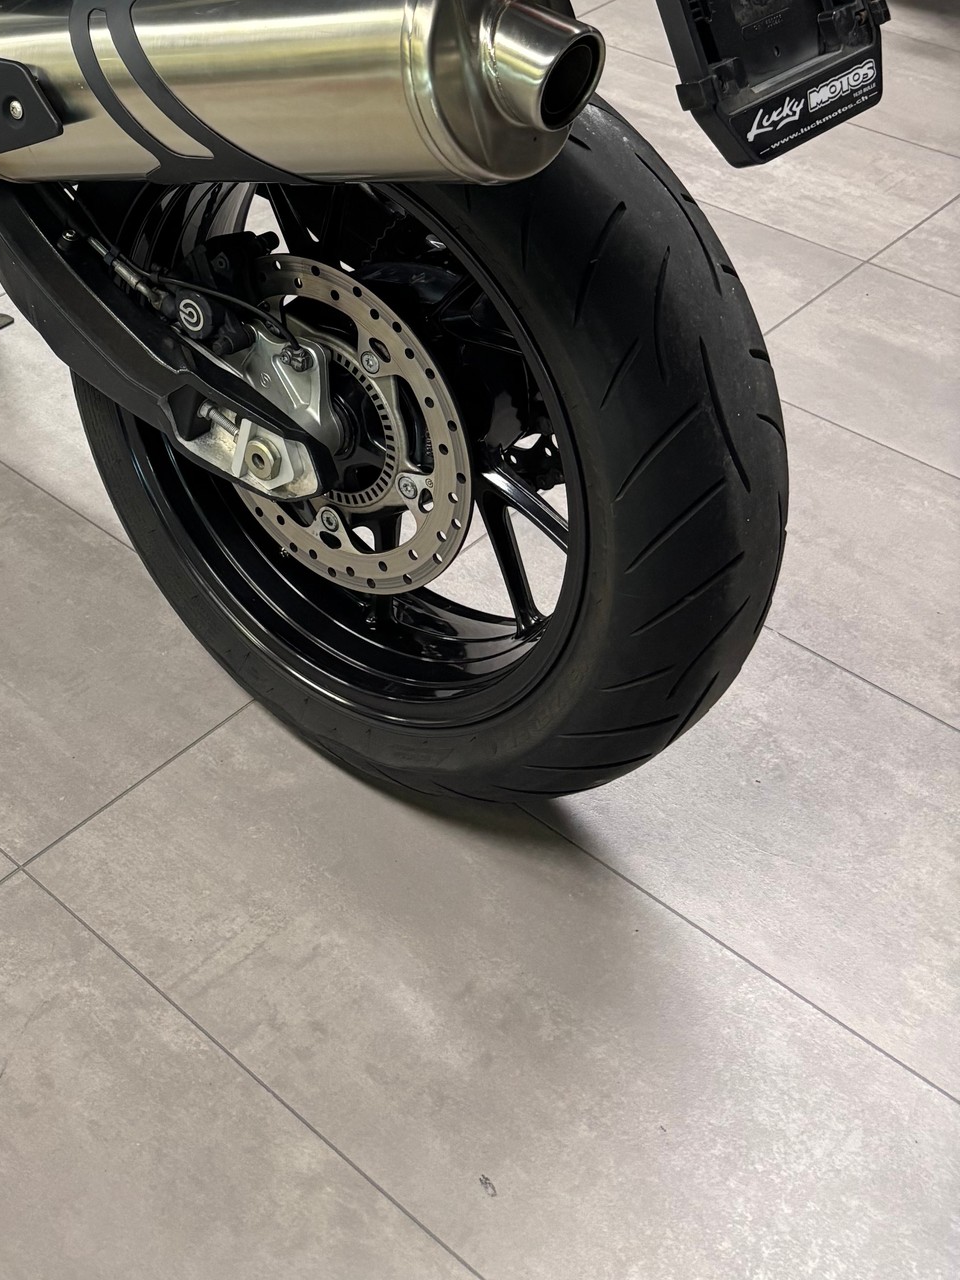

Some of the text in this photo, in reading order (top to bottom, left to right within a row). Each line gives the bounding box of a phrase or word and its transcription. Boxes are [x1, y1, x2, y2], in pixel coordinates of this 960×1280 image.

[746, 59, 877, 142] Lucky MOTOS
[771, 94, 869, 149] www.luckmotos.ch
